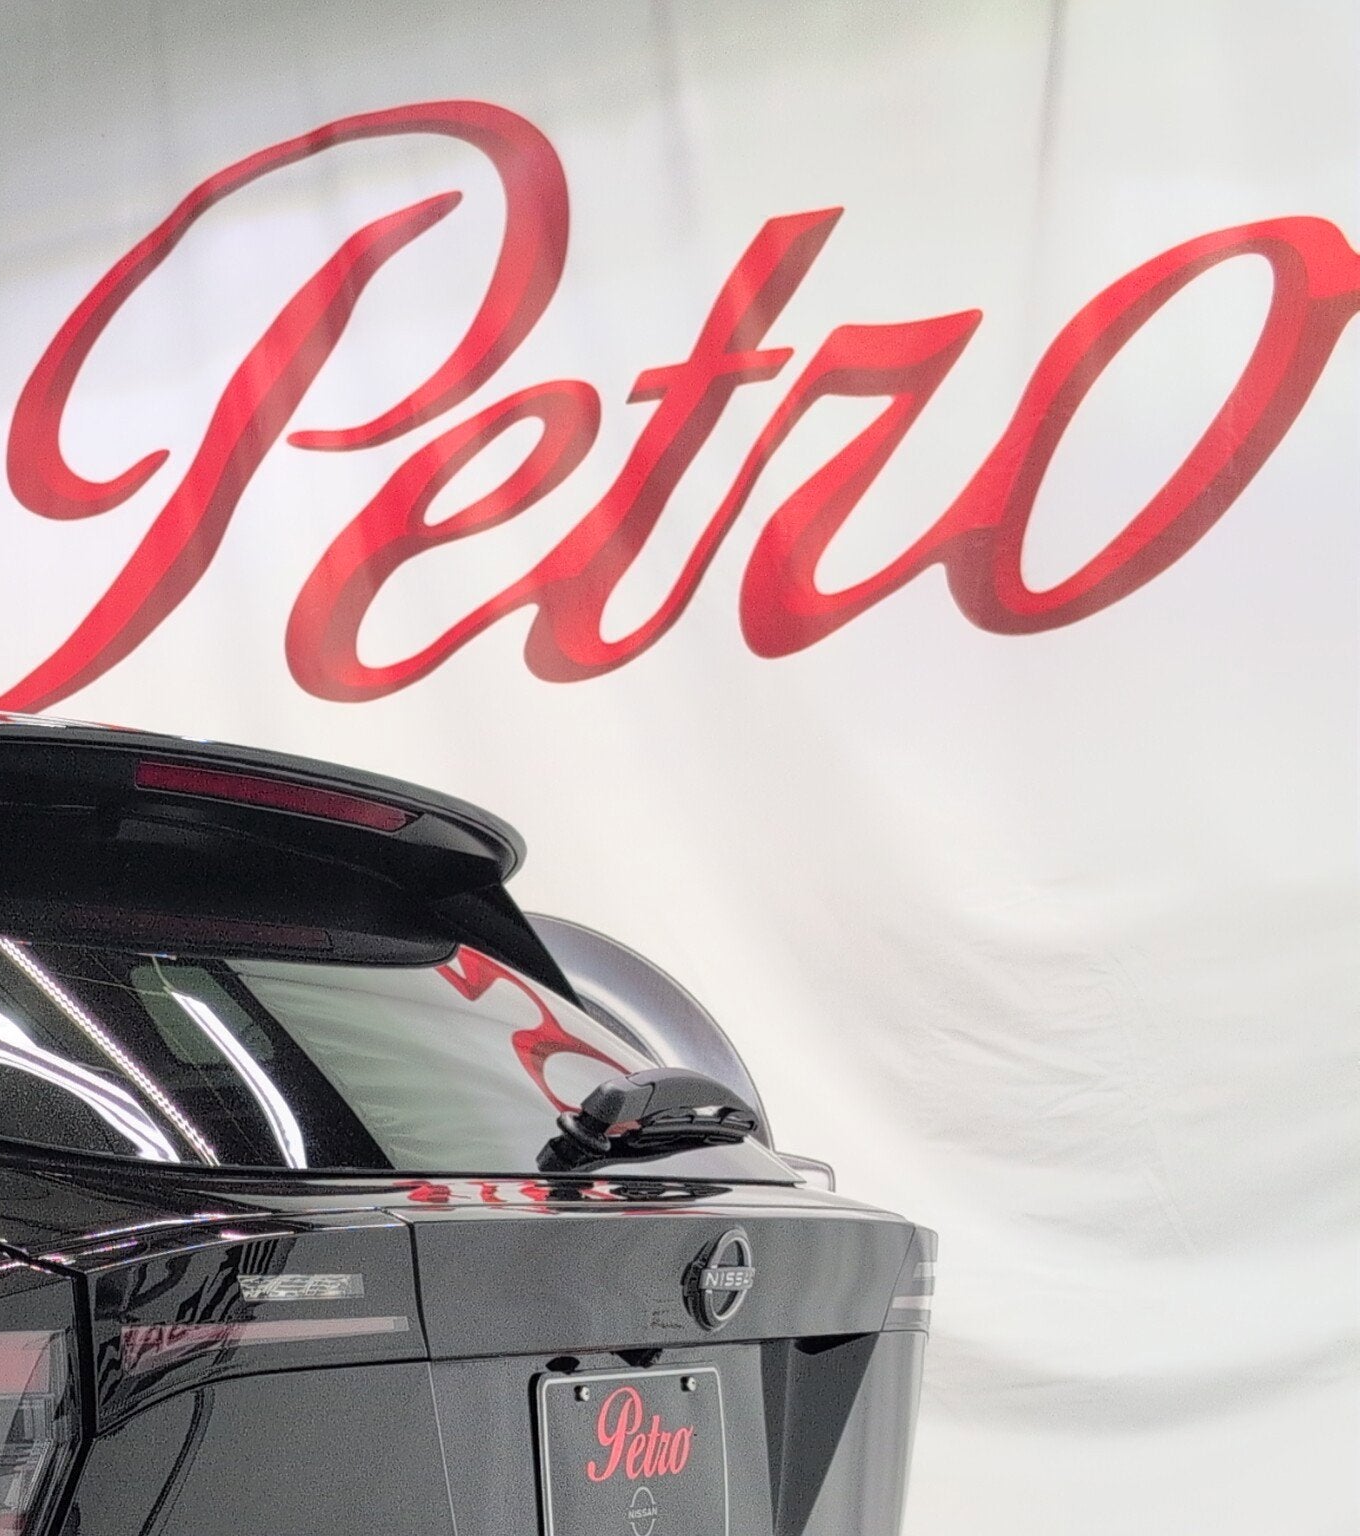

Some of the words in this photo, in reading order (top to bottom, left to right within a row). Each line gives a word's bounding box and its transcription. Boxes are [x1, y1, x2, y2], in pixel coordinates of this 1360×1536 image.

[703, 1269, 753, 1286] NISSA
[586, 1386, 694, 1482] Petro
[627, 1504, 659, 1519] NISSAN
